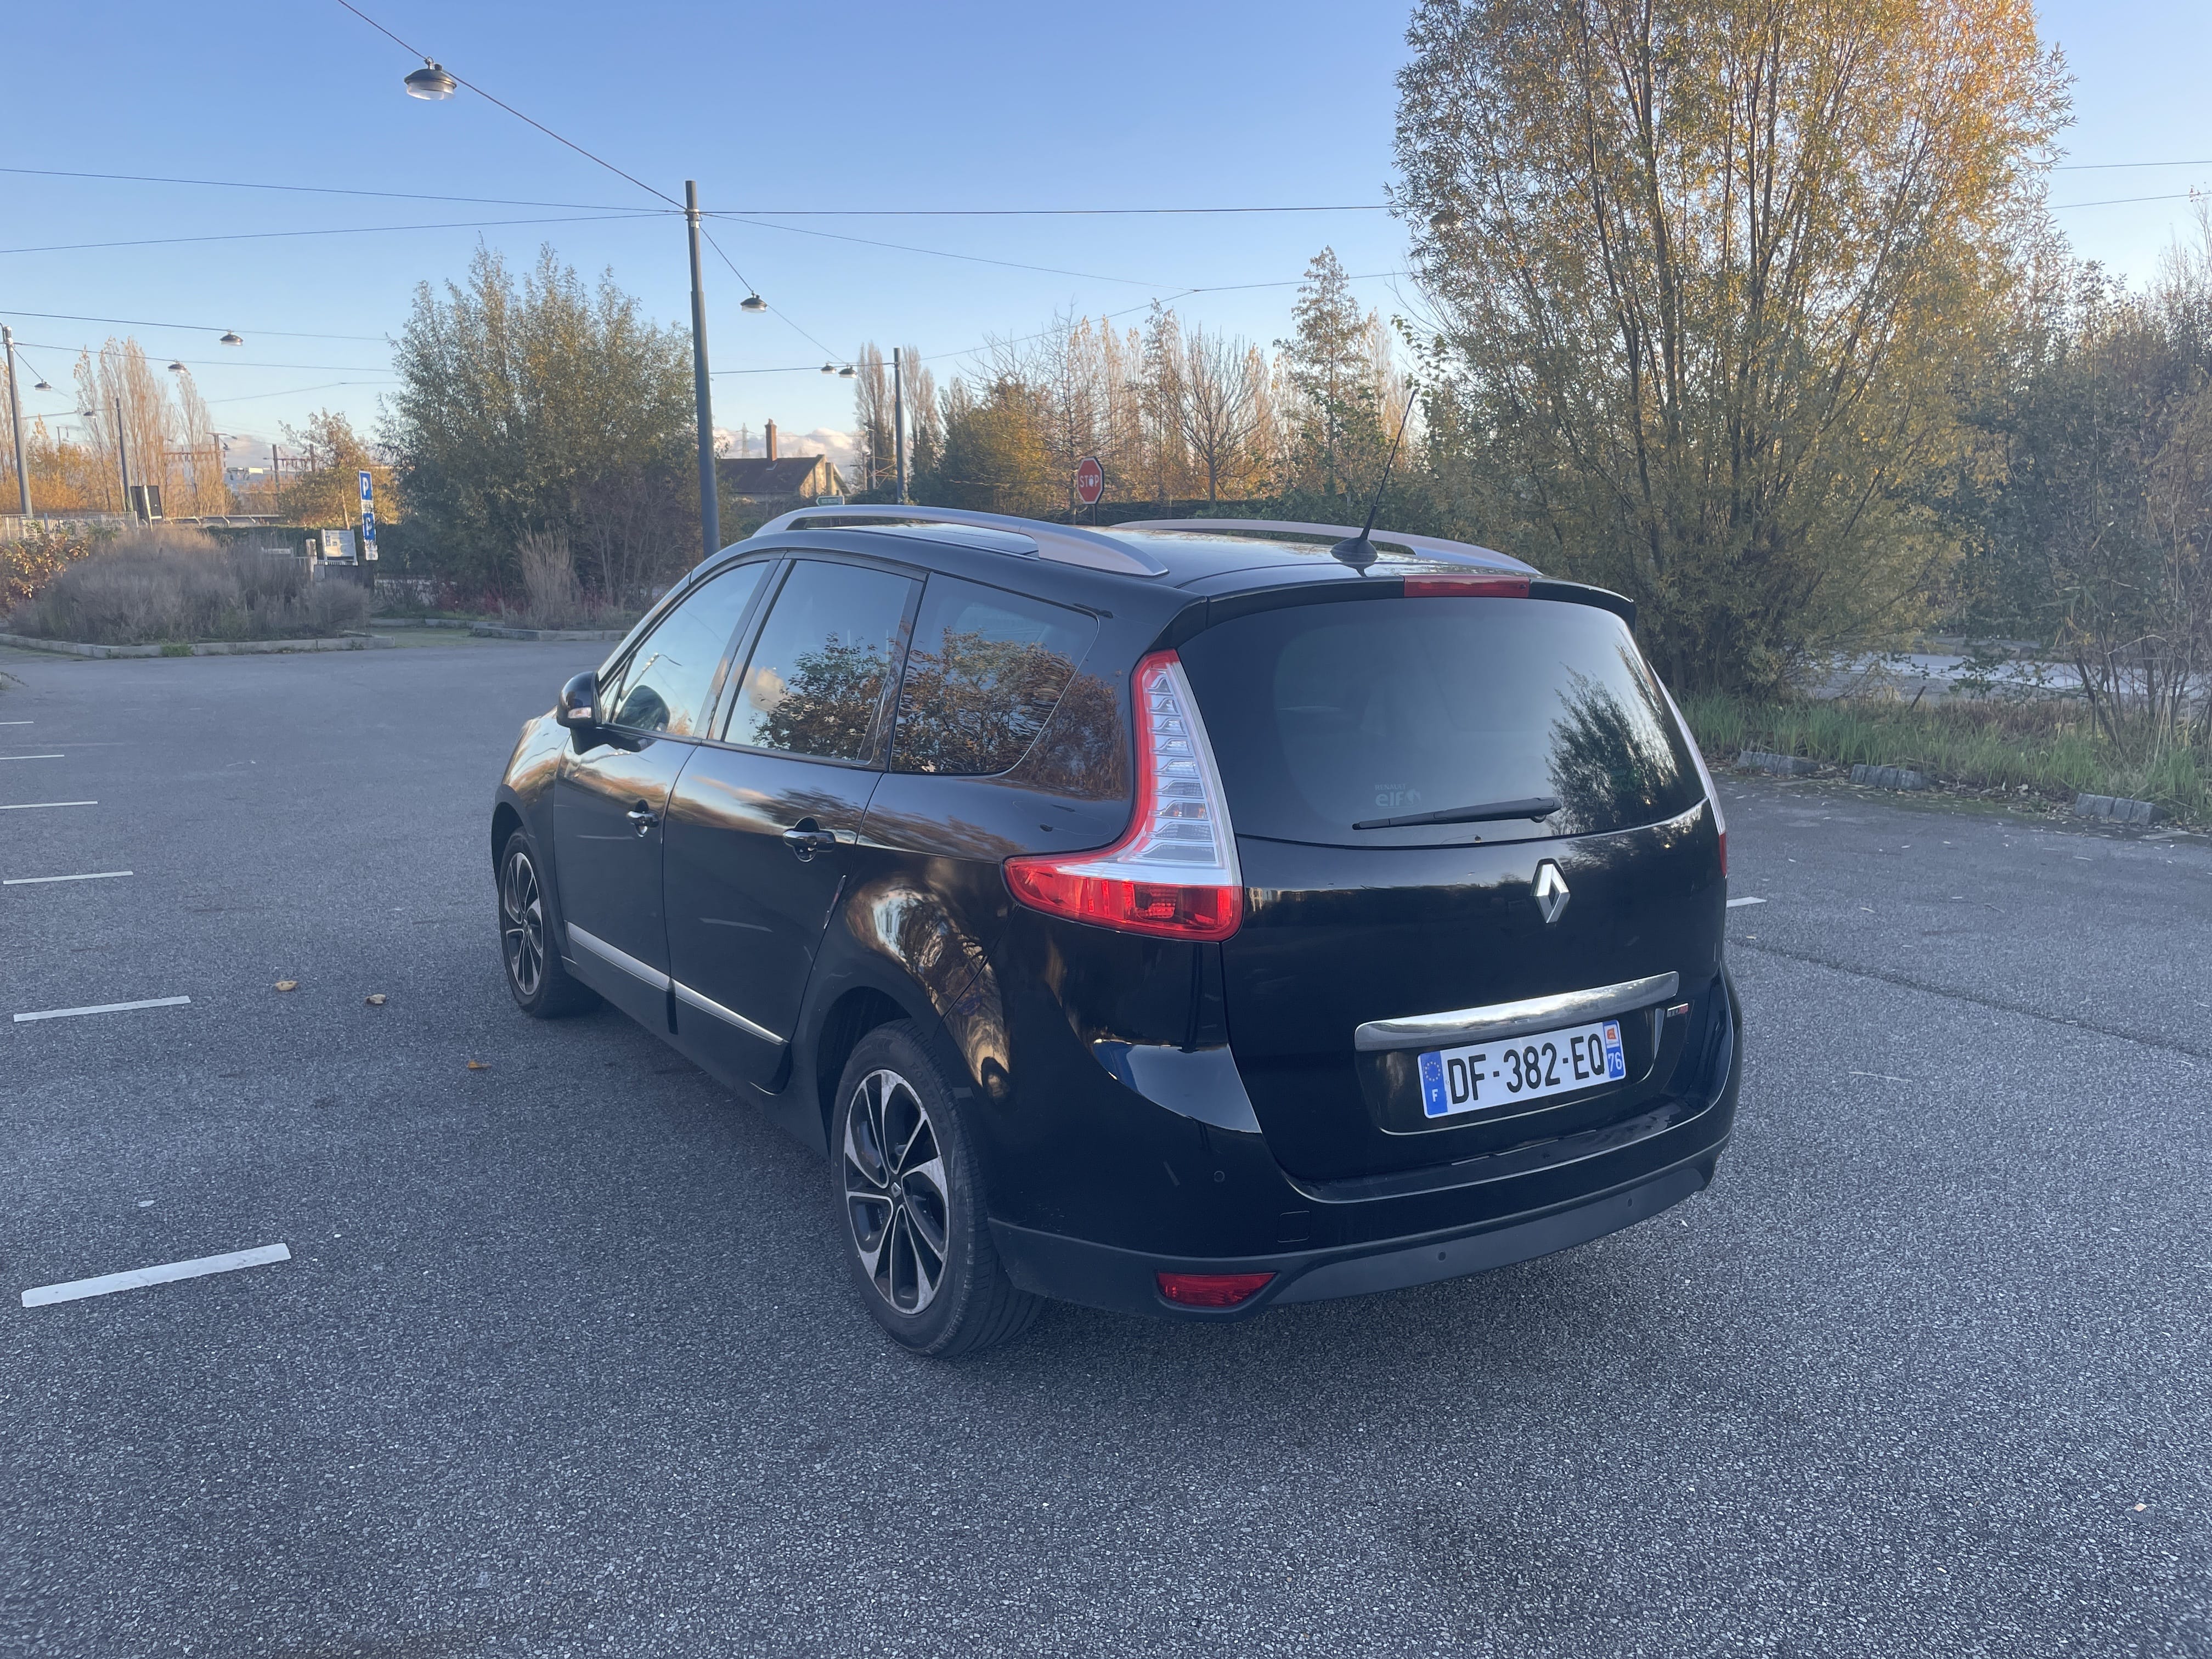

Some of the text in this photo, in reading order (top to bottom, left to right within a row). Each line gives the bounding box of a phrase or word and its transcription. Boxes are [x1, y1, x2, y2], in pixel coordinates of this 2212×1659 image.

[363, 477, 369, 496] P
[1080, 475, 1099, 487] STOP
[1375, 791, 1404, 807] elf
[1607, 1052, 1622, 1073] 76
[1432, 1088, 1438, 1102] F
